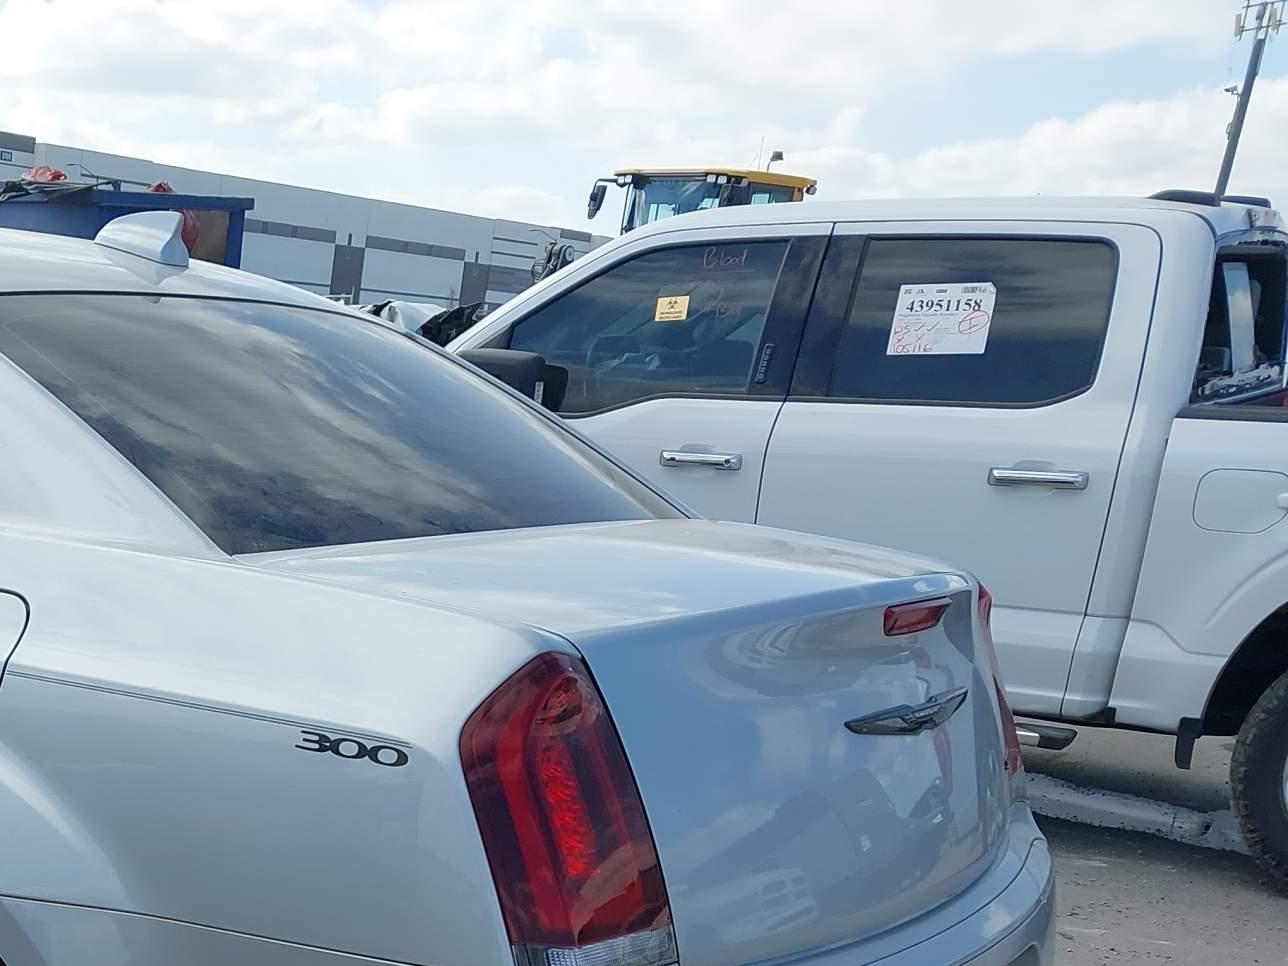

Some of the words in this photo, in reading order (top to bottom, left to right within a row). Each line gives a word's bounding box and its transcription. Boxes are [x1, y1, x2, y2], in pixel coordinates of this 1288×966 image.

[704, 246, 748, 268] Blood
[905, 299, 983, 312] 43951158
[295, 730, 409, 767] 300
